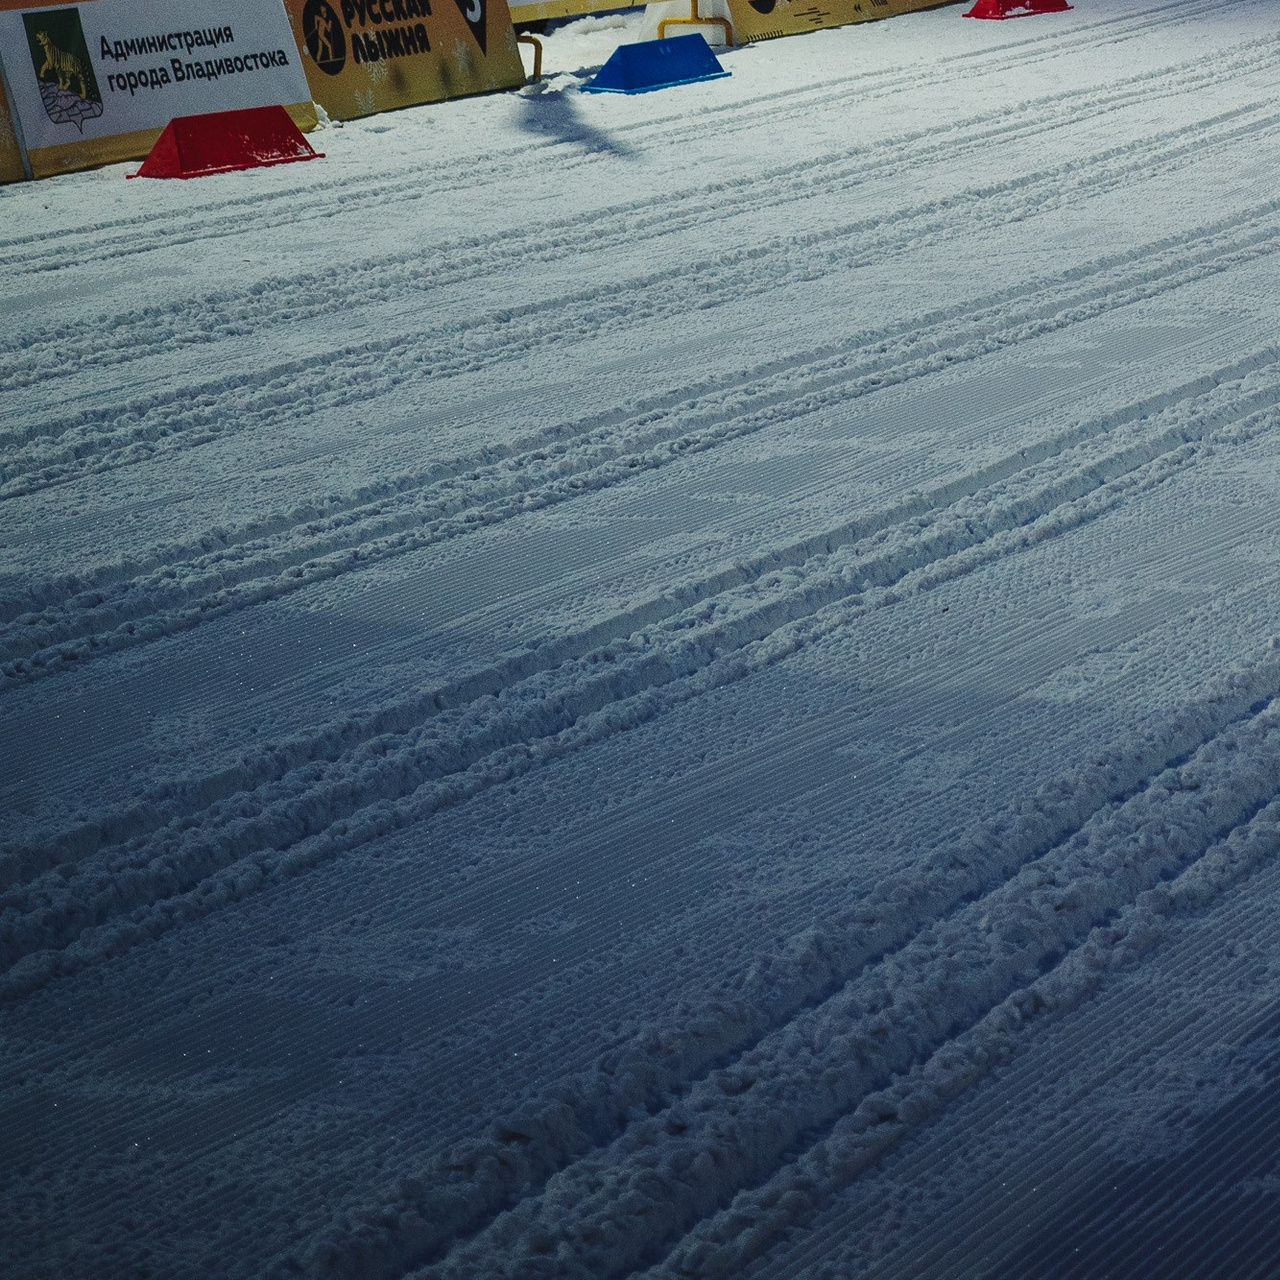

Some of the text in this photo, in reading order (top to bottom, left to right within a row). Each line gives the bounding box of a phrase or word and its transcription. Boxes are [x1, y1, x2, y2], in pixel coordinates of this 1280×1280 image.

[100, 26, 234, 62] Администрация
[351, 23, 431, 64] ЛЫЖНЯ
[107, 49, 289, 96] города Владивостока
